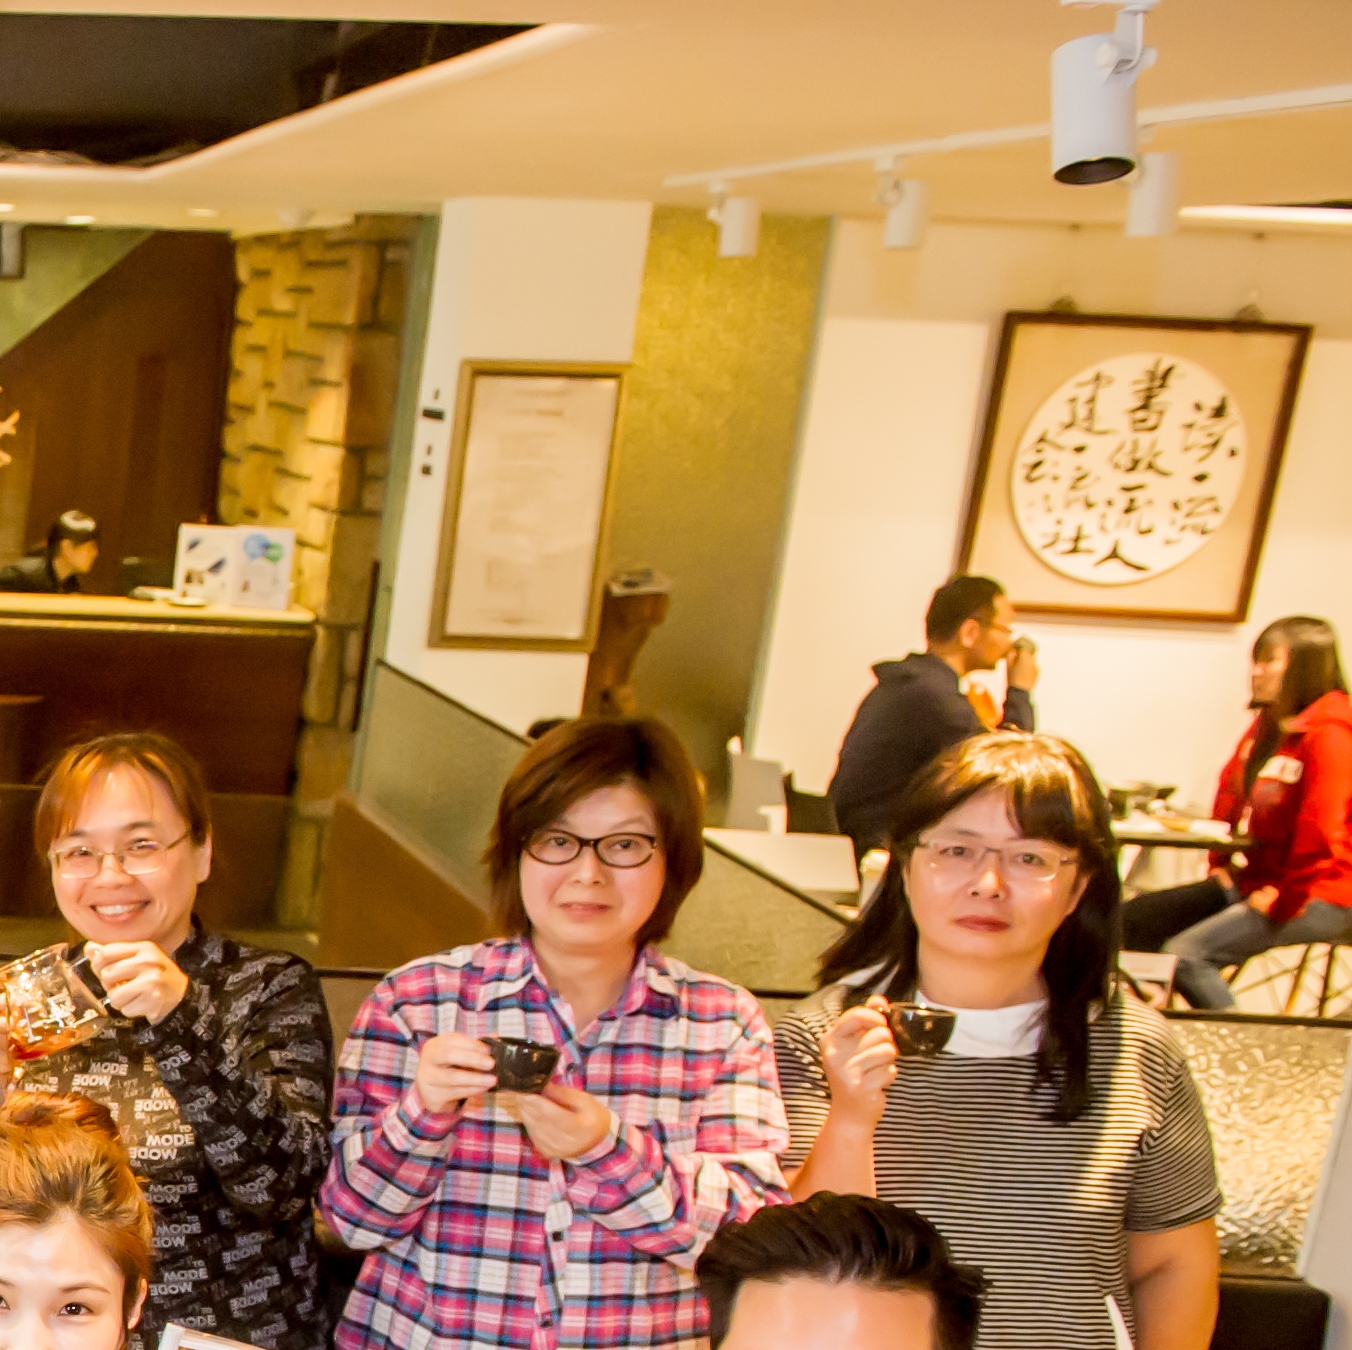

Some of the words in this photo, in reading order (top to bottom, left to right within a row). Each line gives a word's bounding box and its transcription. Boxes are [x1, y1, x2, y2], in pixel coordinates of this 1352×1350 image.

[90, 1062, 129, 1075] MODE
[134, 1099, 175, 1112] MODE
[146, 1133, 195, 1147] MODE
[129, 1147, 178, 1161] MODE
[149, 1182, 198, 1195] MODE
[156, 1222, 201, 1236] MODE
[164, 1267, 208, 1283] MODE
[149, 1282, 193, 1296] MODE
